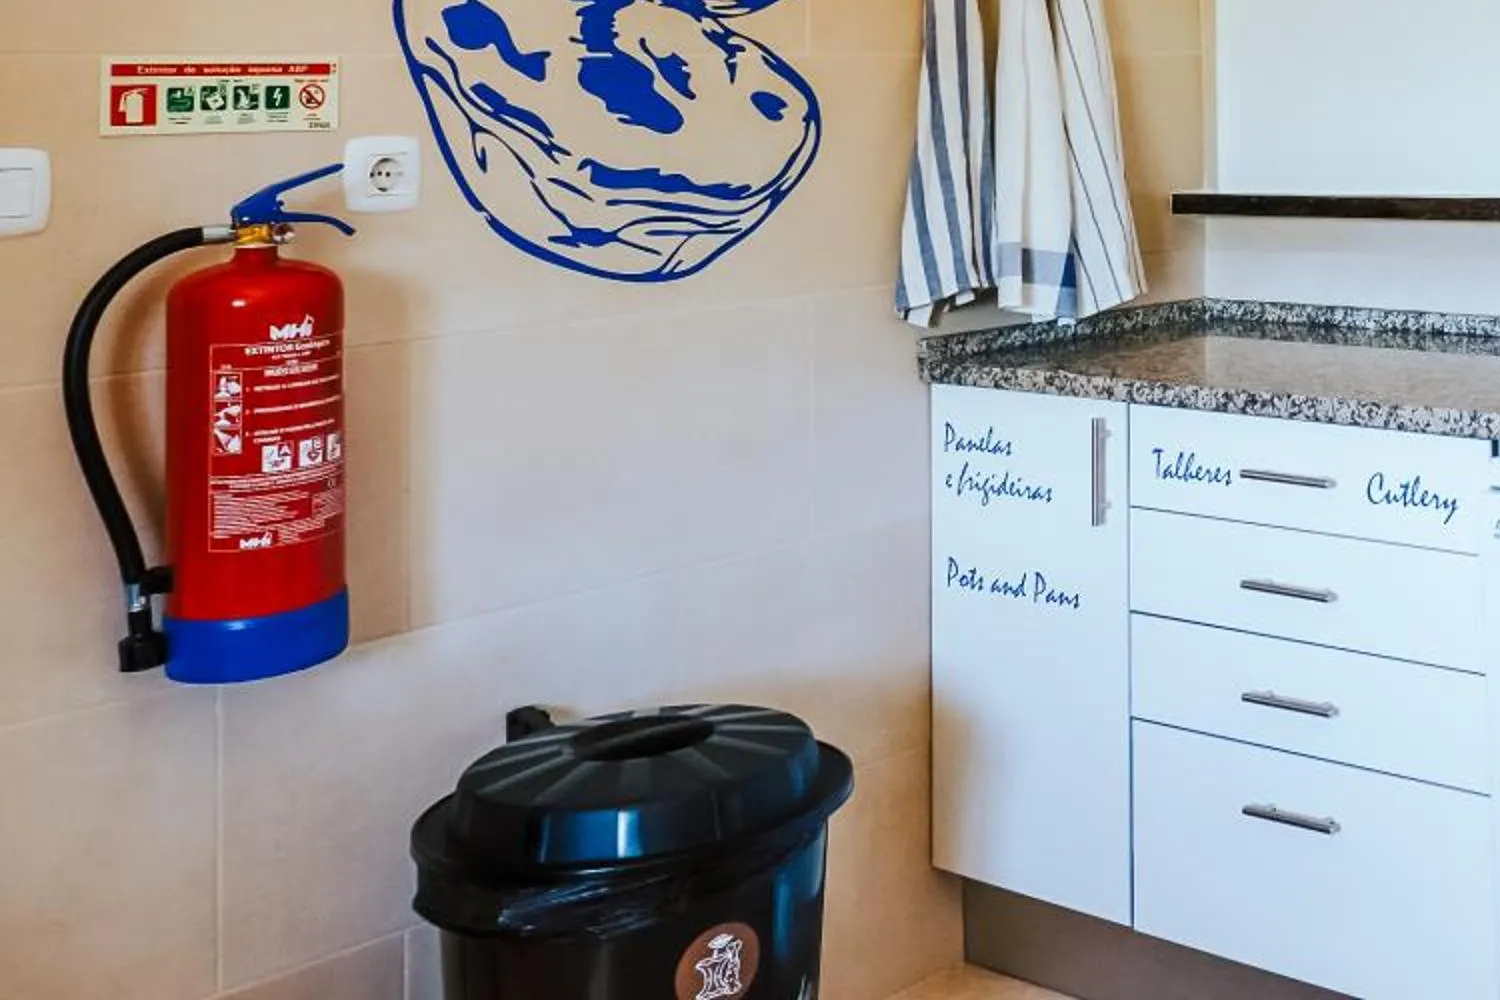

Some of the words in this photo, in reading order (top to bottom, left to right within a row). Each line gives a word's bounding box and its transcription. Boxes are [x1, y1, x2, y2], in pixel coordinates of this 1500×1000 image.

[944, 421, 1012, 456] Panelas
[957, 461, 1053, 507] frigideiras
[1152, 447, 1233, 487] Talheres
[1367, 471, 1459, 525] Cutlery
[947, 556, 984, 591] Pots
[990, 572, 1027, 598] and
[1033, 571, 1080, 609] Pans
